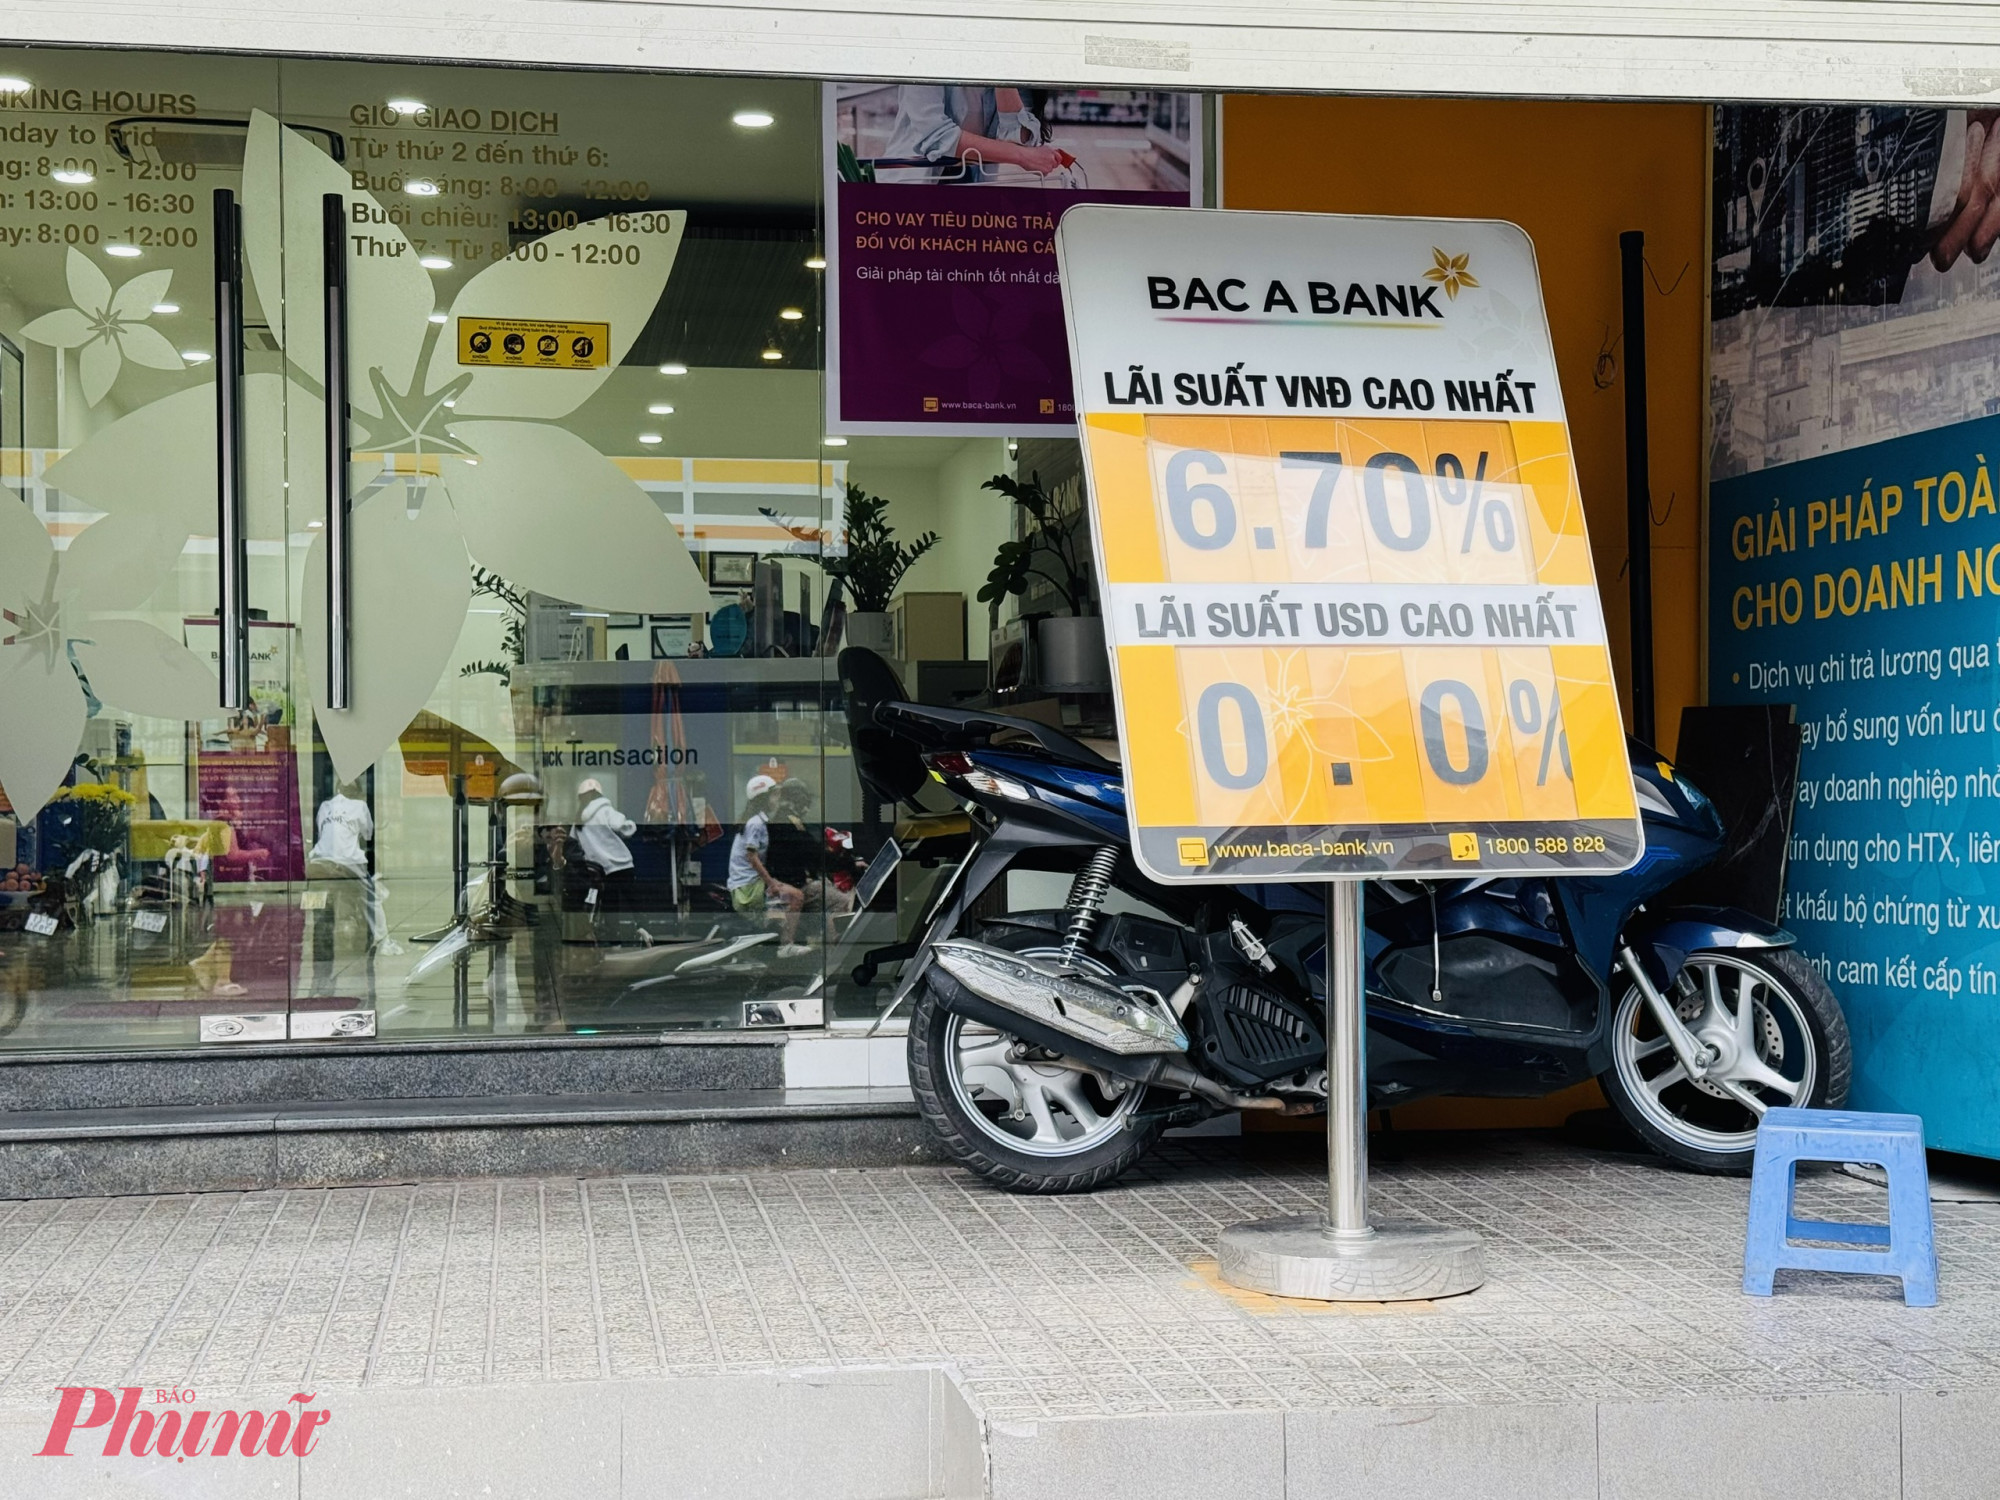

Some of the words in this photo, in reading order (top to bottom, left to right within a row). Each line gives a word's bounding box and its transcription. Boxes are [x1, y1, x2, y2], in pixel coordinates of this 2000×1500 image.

[93, 90, 196, 114] HOURS
[70, 125, 96, 145] to
[412, 106, 481, 130] GIAO
[491, 110, 559, 134] DỊCH
[350, 137, 388, 159] Từ
[397, 140, 443, 162] thứ
[451, 142, 466, 162] 2
[475, 140, 523, 164] đến
[532, 144, 578, 167] thứ
[587, 148, 608, 168] 6:
[124, 162, 197, 181] 12:00
[24, 190, 98, 211] 13:00
[124, 193, 194, 214] 16:30
[501, 176, 557, 198] 8:00
[582, 180, 650, 200] 12:00
[352, 202, 411, 227] Buổi
[421, 203, 497, 229] chiều:
[511, 209, 578, 231] 13:00
[605, 212, 670, 234] 16:30
[856, 211, 890, 226] CHO
[896, 213, 925, 227] VAY
[930, 211, 966, 228] TIÊU
[971, 212, 1018, 230] DÙNG
[1022, 211, 1054, 230] TRẢ
[37, 223, 99, 245] 8:00
[124, 226, 198, 248] 12:00
[351, 236, 406, 258] Thứ
[571, 243, 640, 265] 12:00
[856, 232, 883, 250] ĐỐI
[888, 235, 915, 250] VỚI
[920, 234, 976, 253] KHÁCH
[982, 236, 1028, 254] HÀNG
[1033, 239, 1056, 255] CÁ
[856, 266, 884, 280] Giải
[888, 266, 922, 284] pháp
[926, 268, 943, 281] tài
[947, 268, 984, 283] chính
[989, 267, 1006, 283] tốt
[1010, 268, 1040, 285] nhất
[1147, 275, 1250, 313] BAC
[1264, 280, 1299, 315] A
[1308, 281, 1444, 319] BANK
[1104, 364, 1163, 406] LÃI
[1173, 361, 1267, 408] SUẤT
[1276, 375, 1352, 408] VNĐ
[1362, 376, 1434, 412] CAO
[1446, 368, 1536, 414] NHẤT
[941, 400, 1017, 410] www.baca-bank.vn
[1165, 449, 1516, 554] 6.70%
[1732, 498, 1796, 562] GIẢI
[1808, 478, 1903, 548] PHÁP
[1914, 453, 2000, 527] TOÀ
[1732, 578, 1803, 631] CHO
[1814, 554, 1942, 620] DOANH
[1135, 594, 1196, 639] LÃI
[1207, 590, 1303, 638] SUẤT
[1314, 603, 1389, 637] USD
[1400, 602, 1473, 638] CAO
[1487, 592, 1577, 639] NHẤT
[1750, 660, 1790, 693] Dịch
[1794, 664, 1815, 690] vụ
[1820, 653, 1844, 683] chi
[1850, 649, 1874, 681] trả
[1881, 647, 1942, 681] lương
[1949, 642, 1990, 677] qua
[1826, 708, 1848, 742] bổ
[1853, 714, 1900, 746] sung
[1906, 701, 1943, 737] vốn
[1950, 703, 1985, 734] lưu
[566, 740, 698, 767] Transaction
[1824, 771, 1881, 802] doanh
[1888, 769, 1957, 808] nghiệp
[1214, 837, 1394, 860] www.baca-bank.vn
[1486, 838, 1531, 855] 1800
[1535, 837, 1570, 854] 588
[1573, 836, 1606, 853] 828
[1814, 833, 1859, 869] dụng
[1865, 833, 1900, 862] cho
[1908, 831, 1961, 868] HTX,
[1796, 889, 1837, 921] khấu
[1844, 893, 1868, 928] bộ
[1873, 889, 1940, 935] chứng
[1946, 896, 1971, 928] từ
[1837, 960, 1879, 985] cam
[1886, 954, 1917, 989] kết
[1923, 956, 1963, 999] cấp
[1969, 961, 1997, 995] tín
